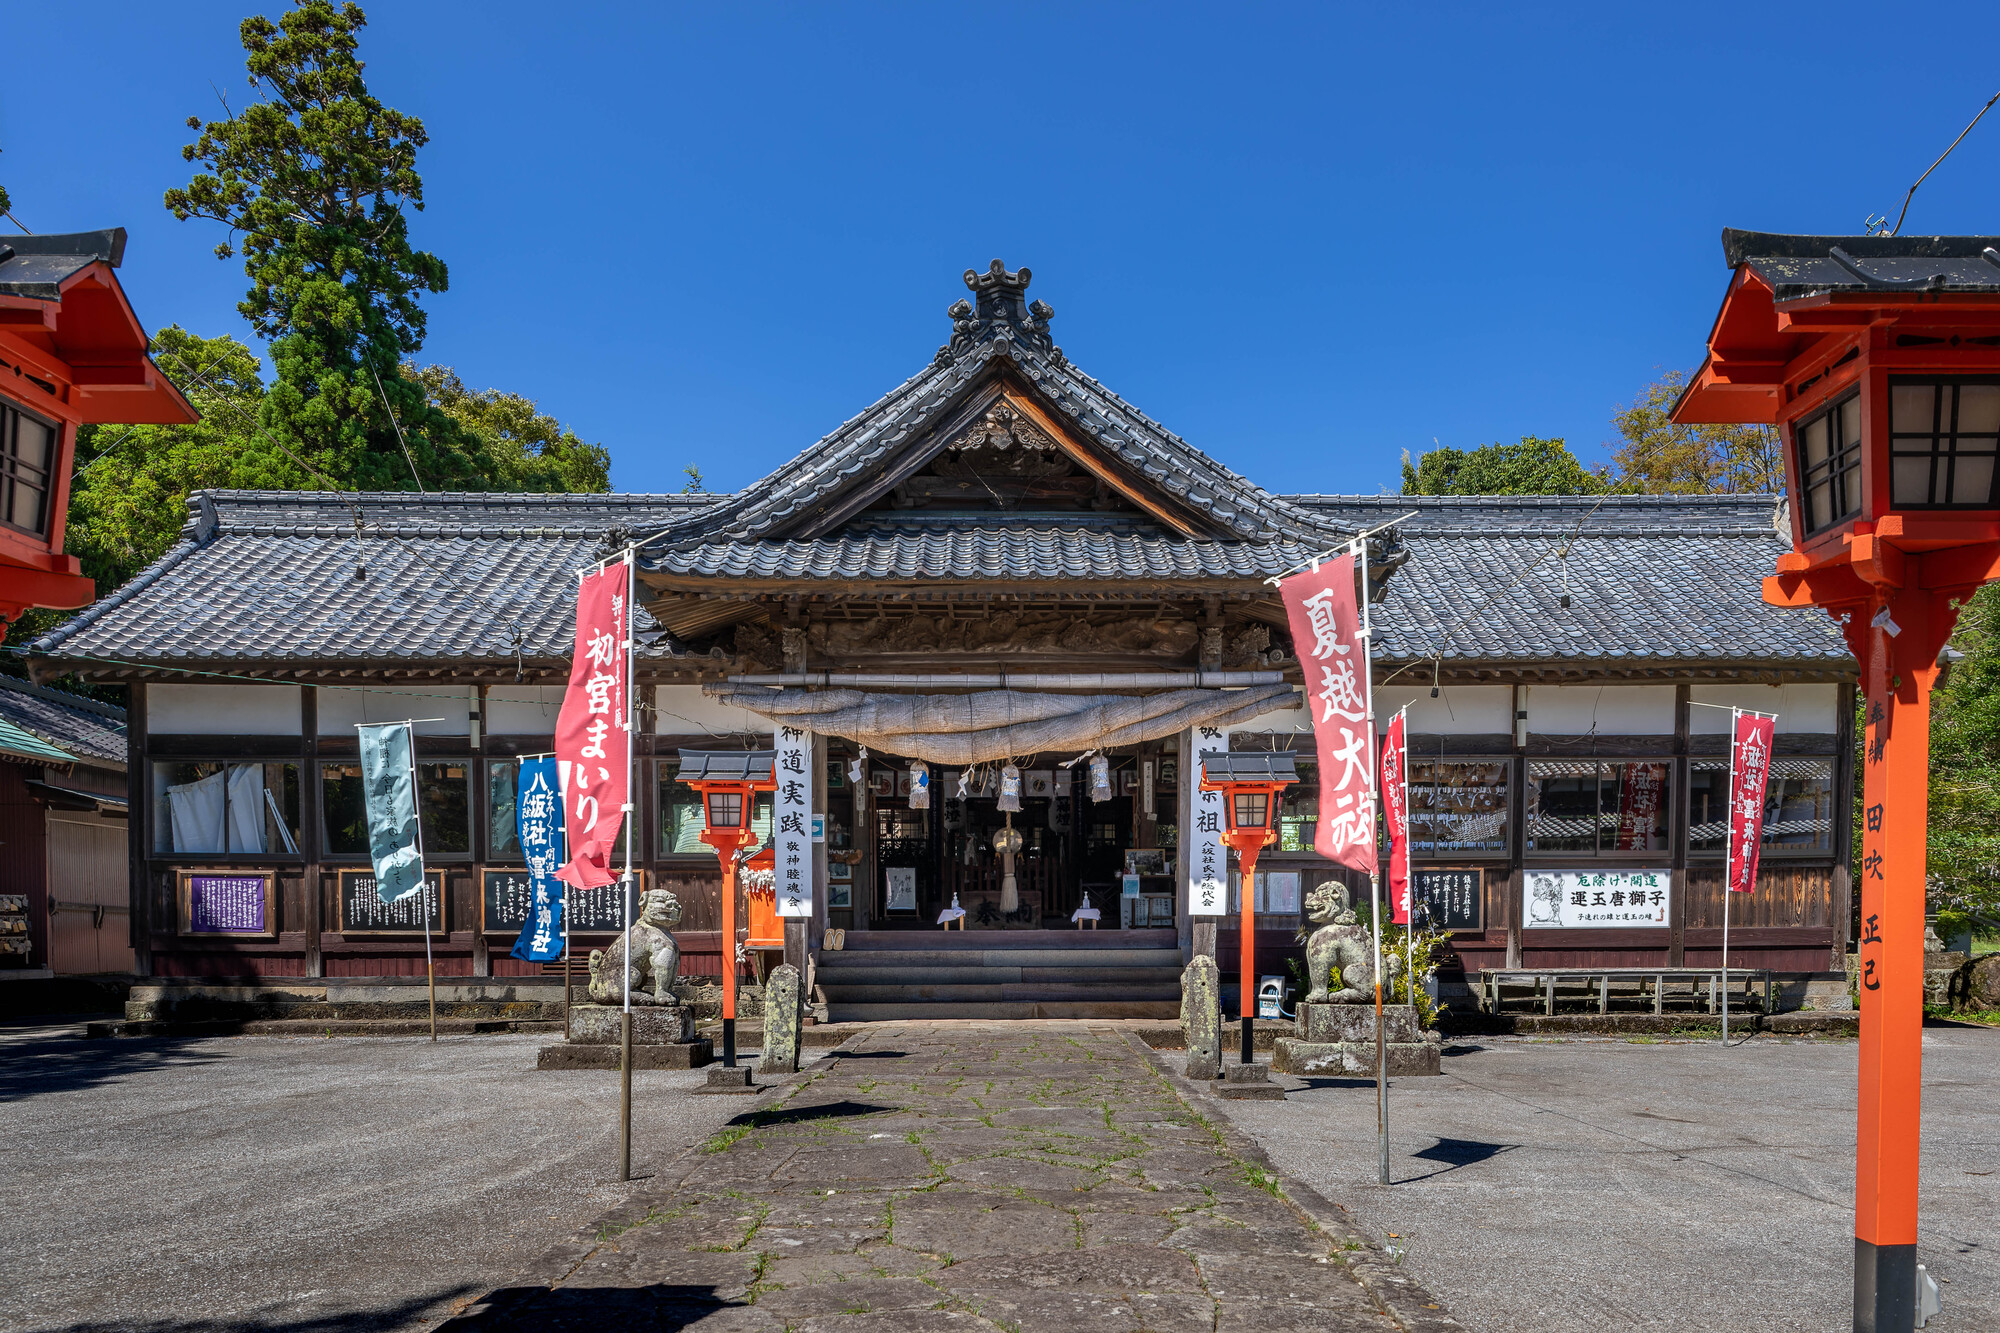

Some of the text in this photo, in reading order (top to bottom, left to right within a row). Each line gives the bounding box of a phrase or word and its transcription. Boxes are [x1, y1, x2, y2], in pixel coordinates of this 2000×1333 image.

[576, 628, 615, 834] 初宮まいり
[1302, 588, 1372, 853] 夏越大祓
[1868, 700, 1885, 766] 奉納
[781, 725, 806, 837] 神道実践
[530, 772, 552, 953] 八坂社・富来神社
[786, 841, 801, 907] 敬神睦魂会
[1201, 840, 1216, 907] 八坂社氏子総代会
[1577, 874, 1659, 887] 厄除け・開運
[1570, 891, 1666, 907] 運玉唐獅子
